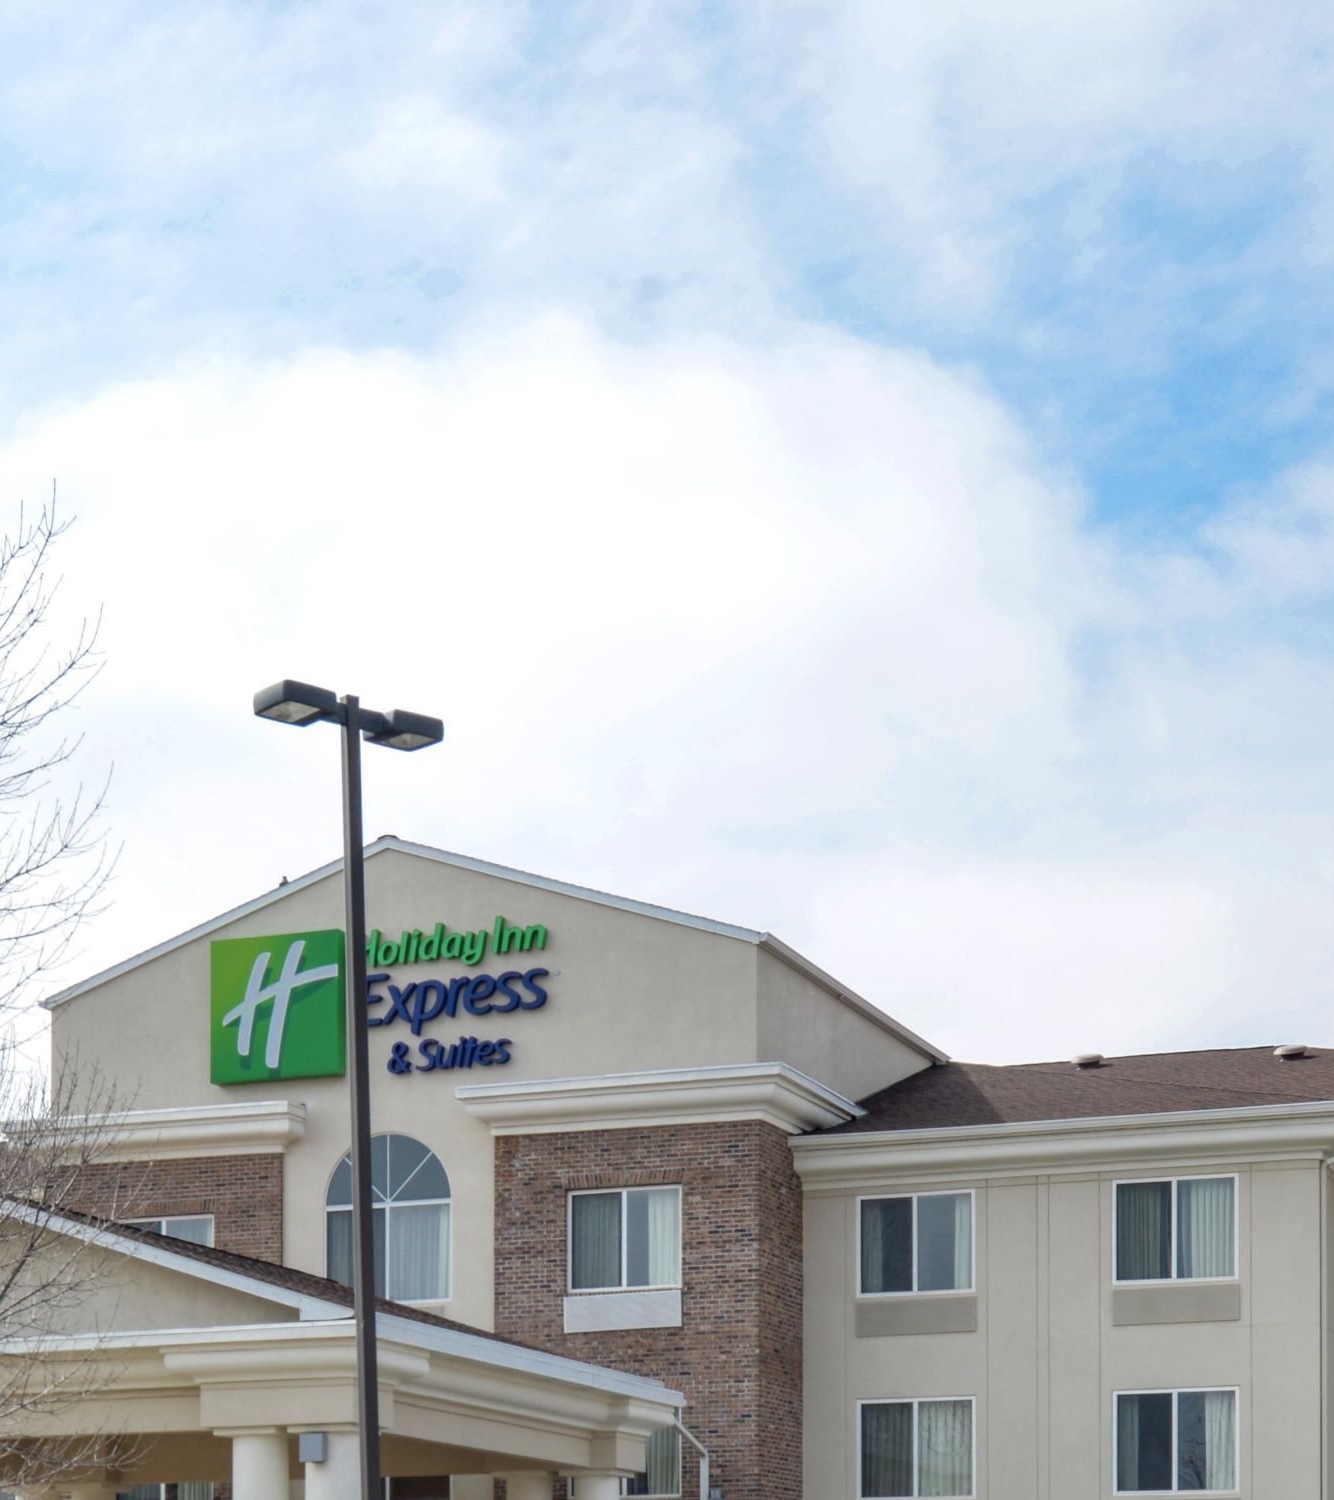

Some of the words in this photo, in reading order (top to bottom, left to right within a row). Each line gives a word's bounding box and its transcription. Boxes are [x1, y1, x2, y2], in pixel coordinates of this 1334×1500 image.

[492, 915, 548, 955] Inn
[367, 967, 550, 1037] Express
[387, 1041, 412, 1075] &
[416, 1036, 513, 1072] Suites
